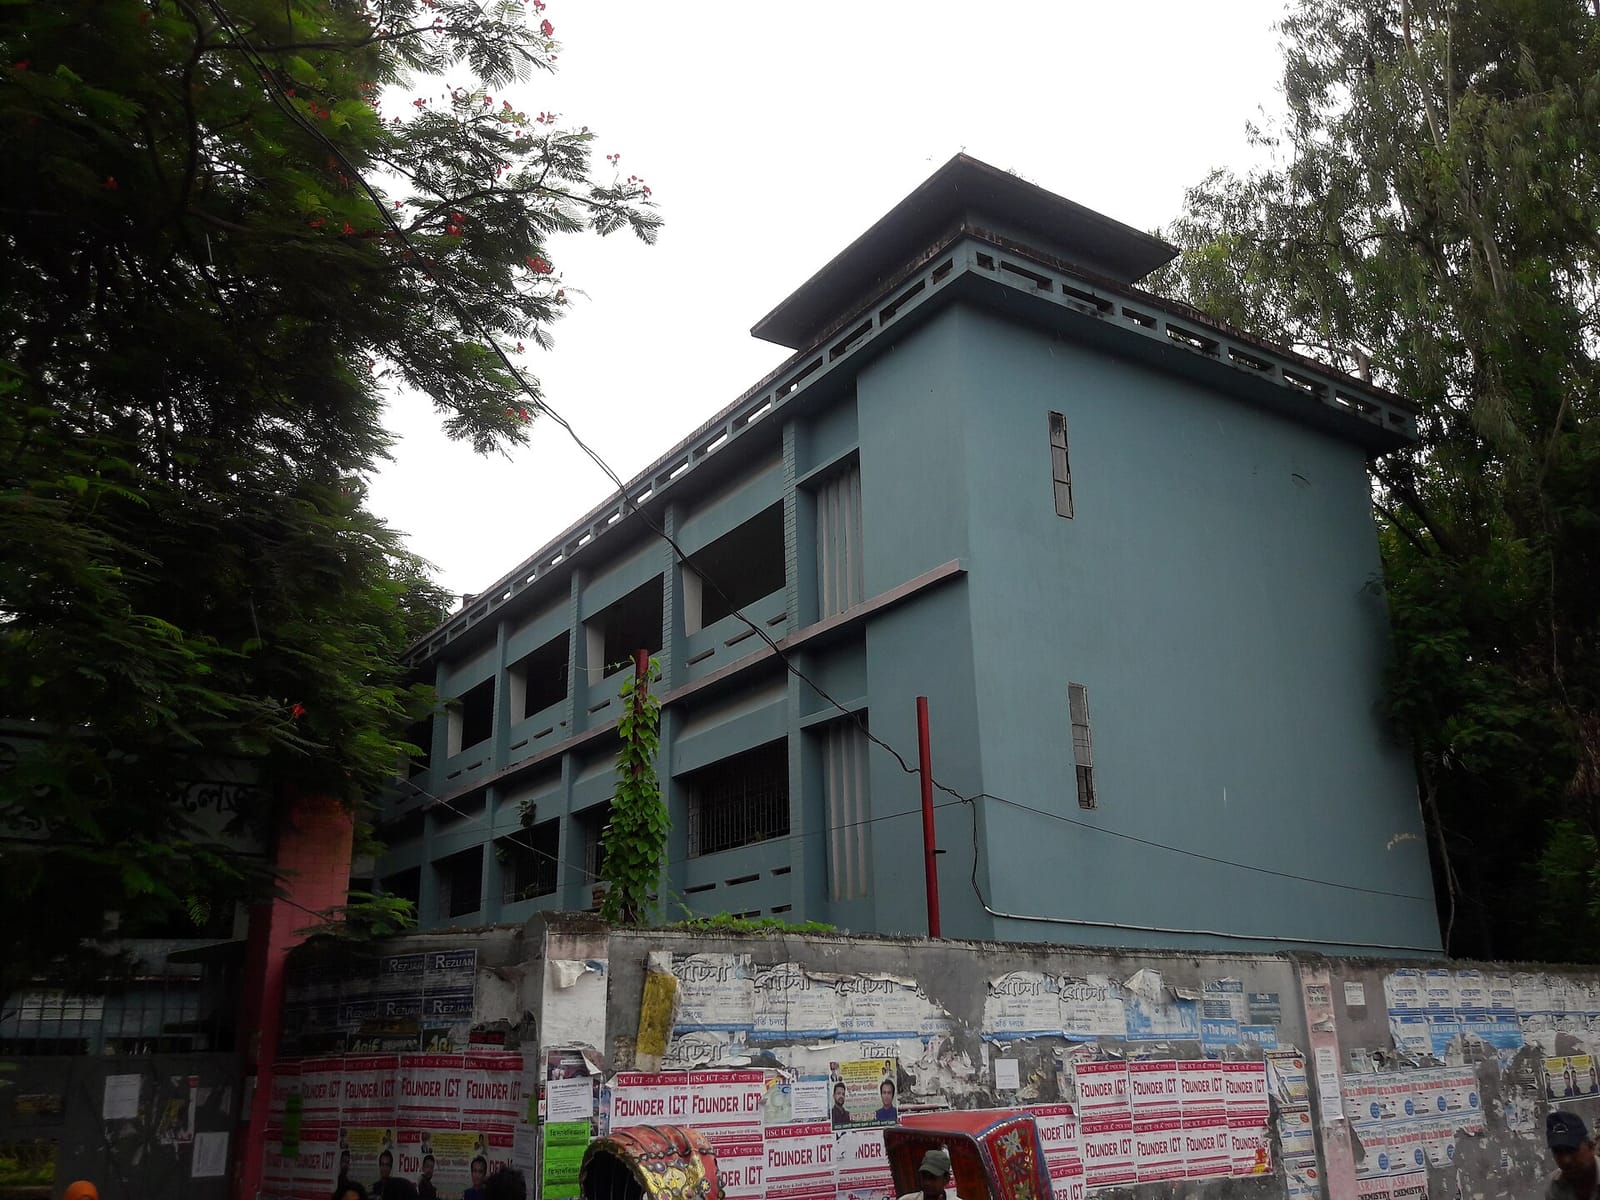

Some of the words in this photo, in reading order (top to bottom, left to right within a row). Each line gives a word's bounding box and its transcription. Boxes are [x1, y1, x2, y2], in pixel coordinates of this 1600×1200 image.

[435, 955, 474, 969] REZUAN
[401, 1077, 440, 1097] FOUNDER
[444, 1078, 461, 1097] ICT
[631, 1076, 644, 1084] ICT
[690, 1074, 705, 1083] HSC
[706, 1073, 718, 1082] ICT
[1133, 1080, 1163, 1095] FOUNDER
[1164, 1078, 1176, 1093] ICT
[1182, 1079, 1210, 1093] FOUNDER
[1211, 1077, 1222, 1091] ICT
[1226, 1080, 1252, 1094] FOUNDER
[1254, 1079, 1264, 1093] ICT
[345, 1080, 379, 1099] FOUNDER
[380, 1079, 395, 1098] ICT
[466, 1080, 508, 1100] FOUNDER
[509, 1080, 521, 1100] ICT
[1080, 1082, 1112, 1098] FOUNDER
[1114, 1079, 1126, 1094] ICT
[614, 1096, 663, 1117] FOUNDER
[668, 1095, 688, 1115] ICT
[692, 1095, 739, 1114] FOUNDER
[743, 1093, 761, 1112] ICT
[765, 1129, 778, 1137] HSC
[781, 1128, 793, 1136] ICT
[1039, 1127, 1060, 1141] NDER
[1063, 1123, 1076, 1139] ICT
[855, 1143, 881, 1159] NDER
[1085, 1142, 1118, 1158] FOUNDER
[1119, 1138, 1132, 1154] ICT
[1137, 1140, 1168, 1156] FOUNDER
[1169, 1136, 1181, 1153] ICT
[1186, 1136, 1215, 1152] FOUNDER
[1216, 1133, 1227, 1148] ICT
[768, 1149, 812, 1168] FOUNDER
[816, 1144, 833, 1162] ICT
[745, 1165, 763, 1185] ICT
[1070, 1184, 1083, 1200] ICT
[1393, 1185, 1425, 1198] CHEMISTRY
